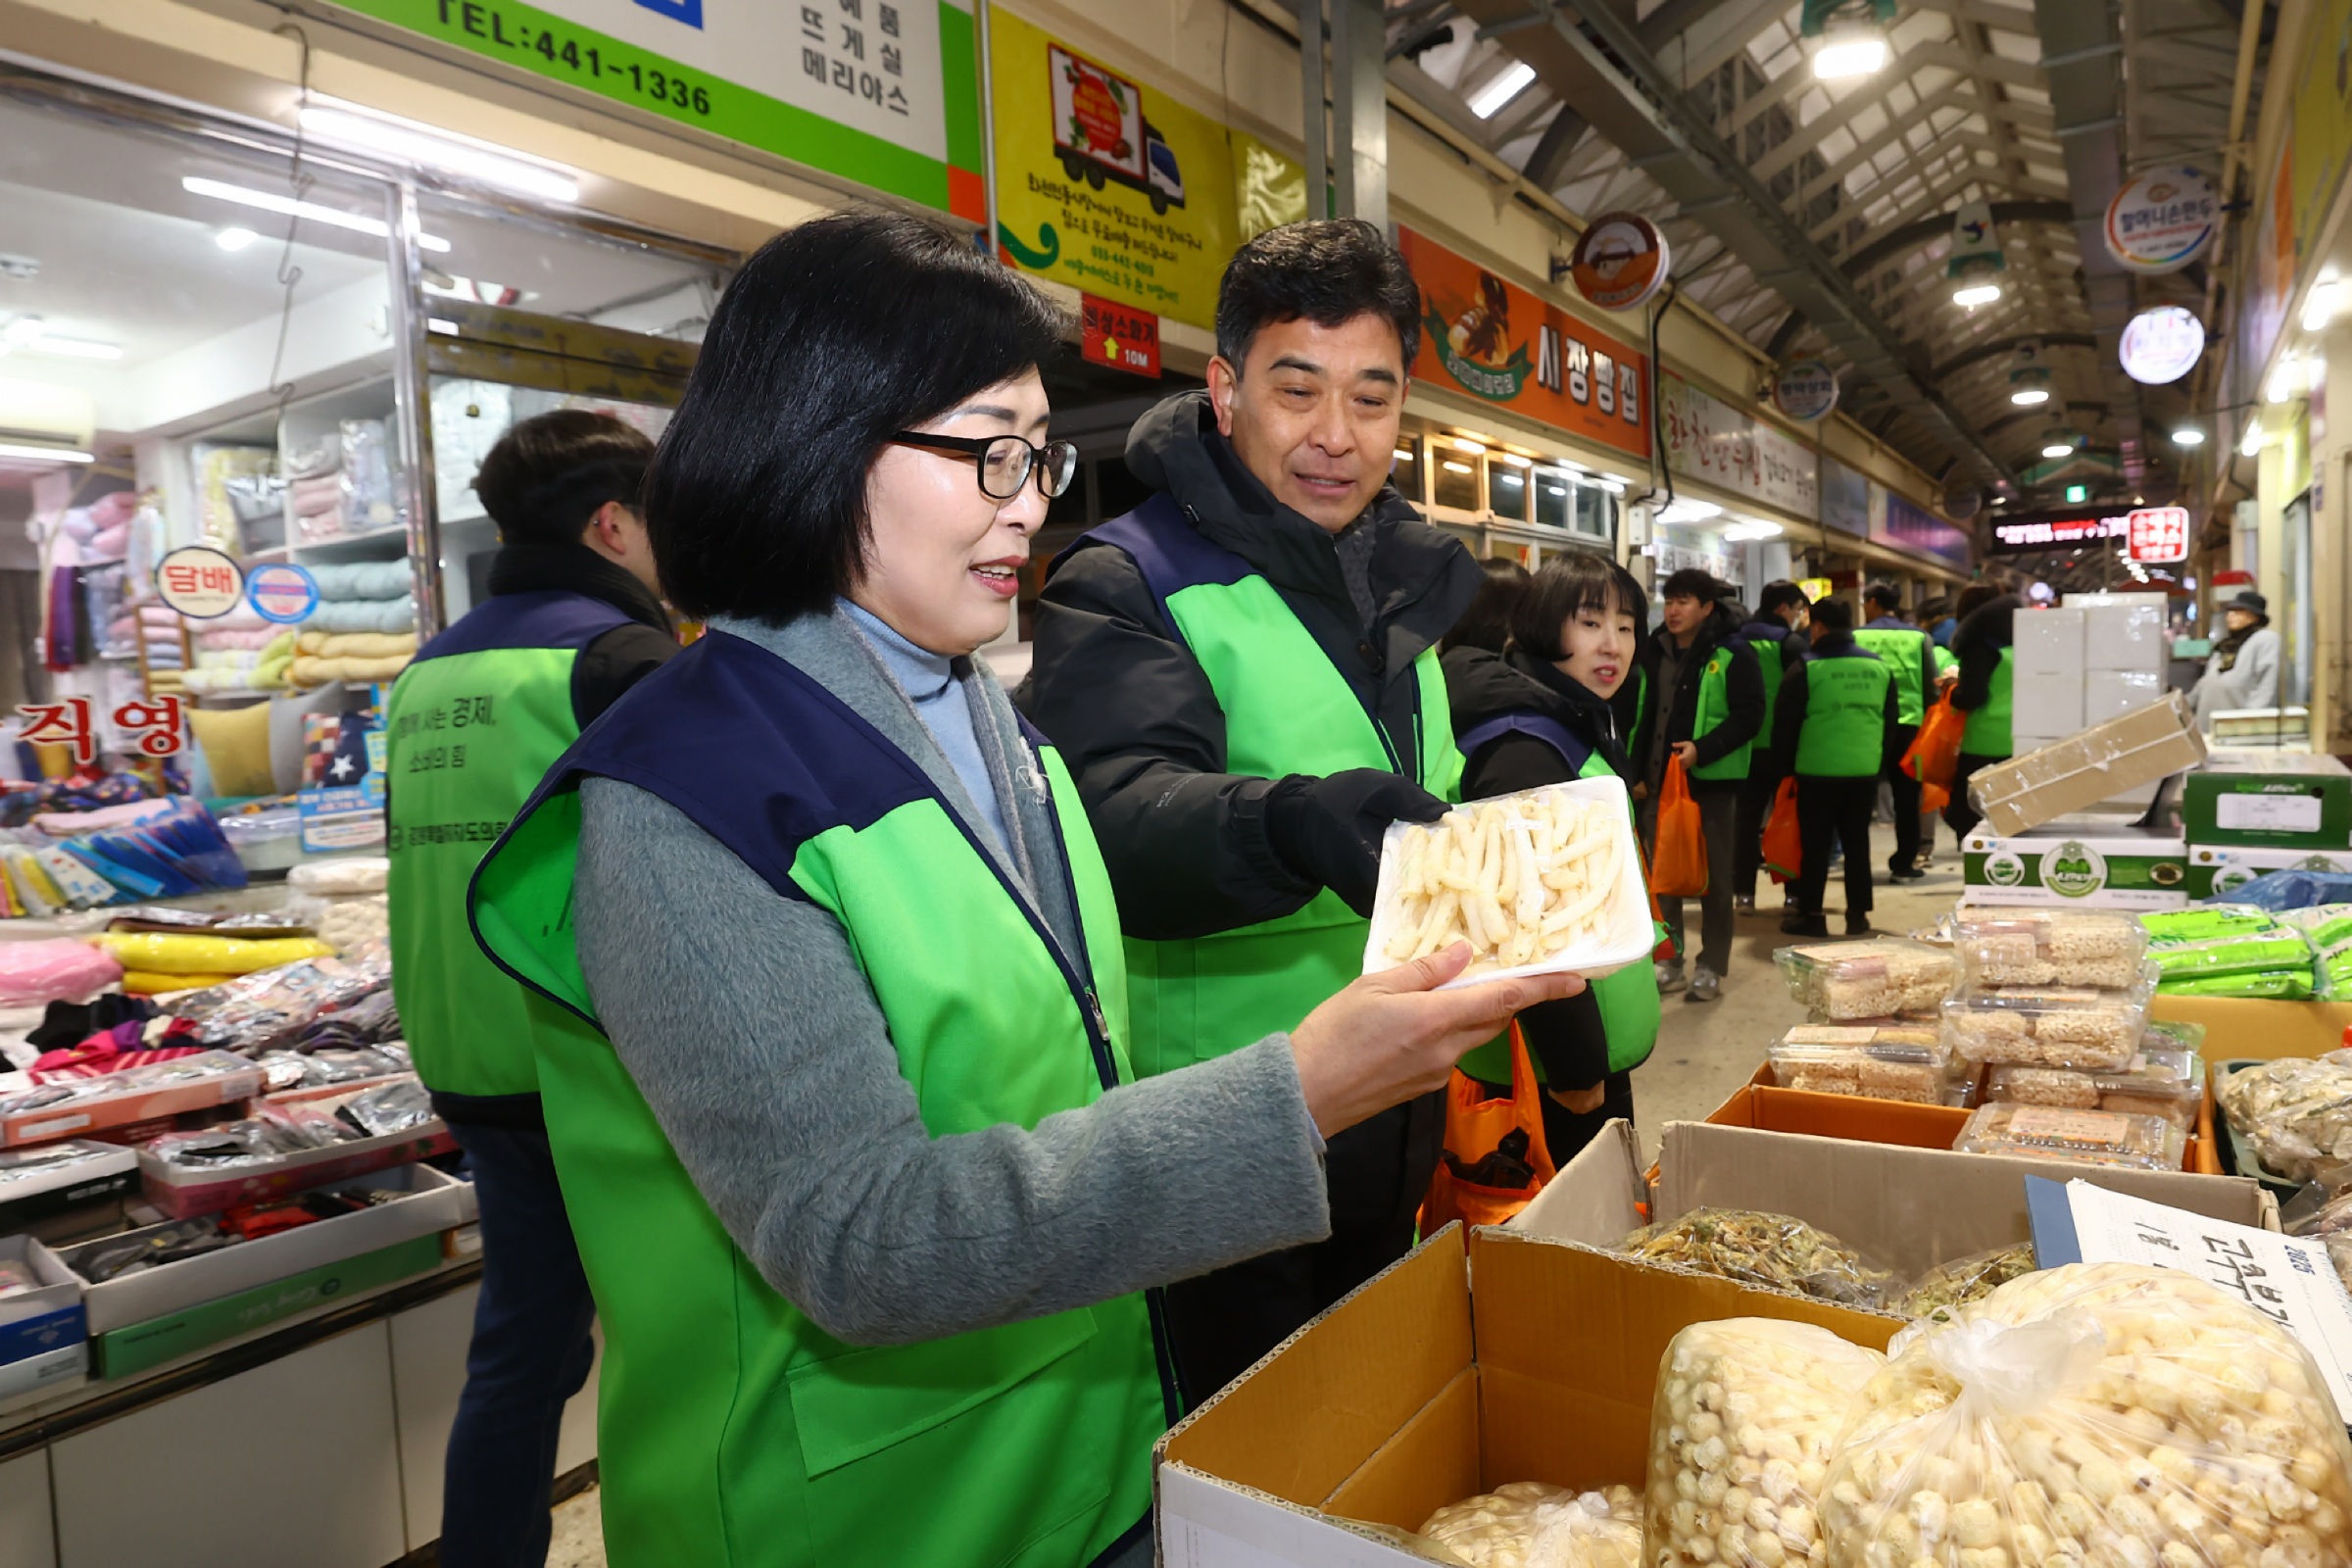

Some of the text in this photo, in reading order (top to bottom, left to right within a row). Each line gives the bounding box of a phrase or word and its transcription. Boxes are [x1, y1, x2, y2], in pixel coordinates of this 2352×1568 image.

[802, 45, 909, 117] 메리야스
[1124, 349, 1149, 368] 10M
[1537, 323, 1641, 425] 시장빵집
[165, 565, 234, 594] 담배
[15, 694, 183, 765] 직영
[451, 744, 466, 768] 힘
[2283, 1245, 2316, 1275] 2025
